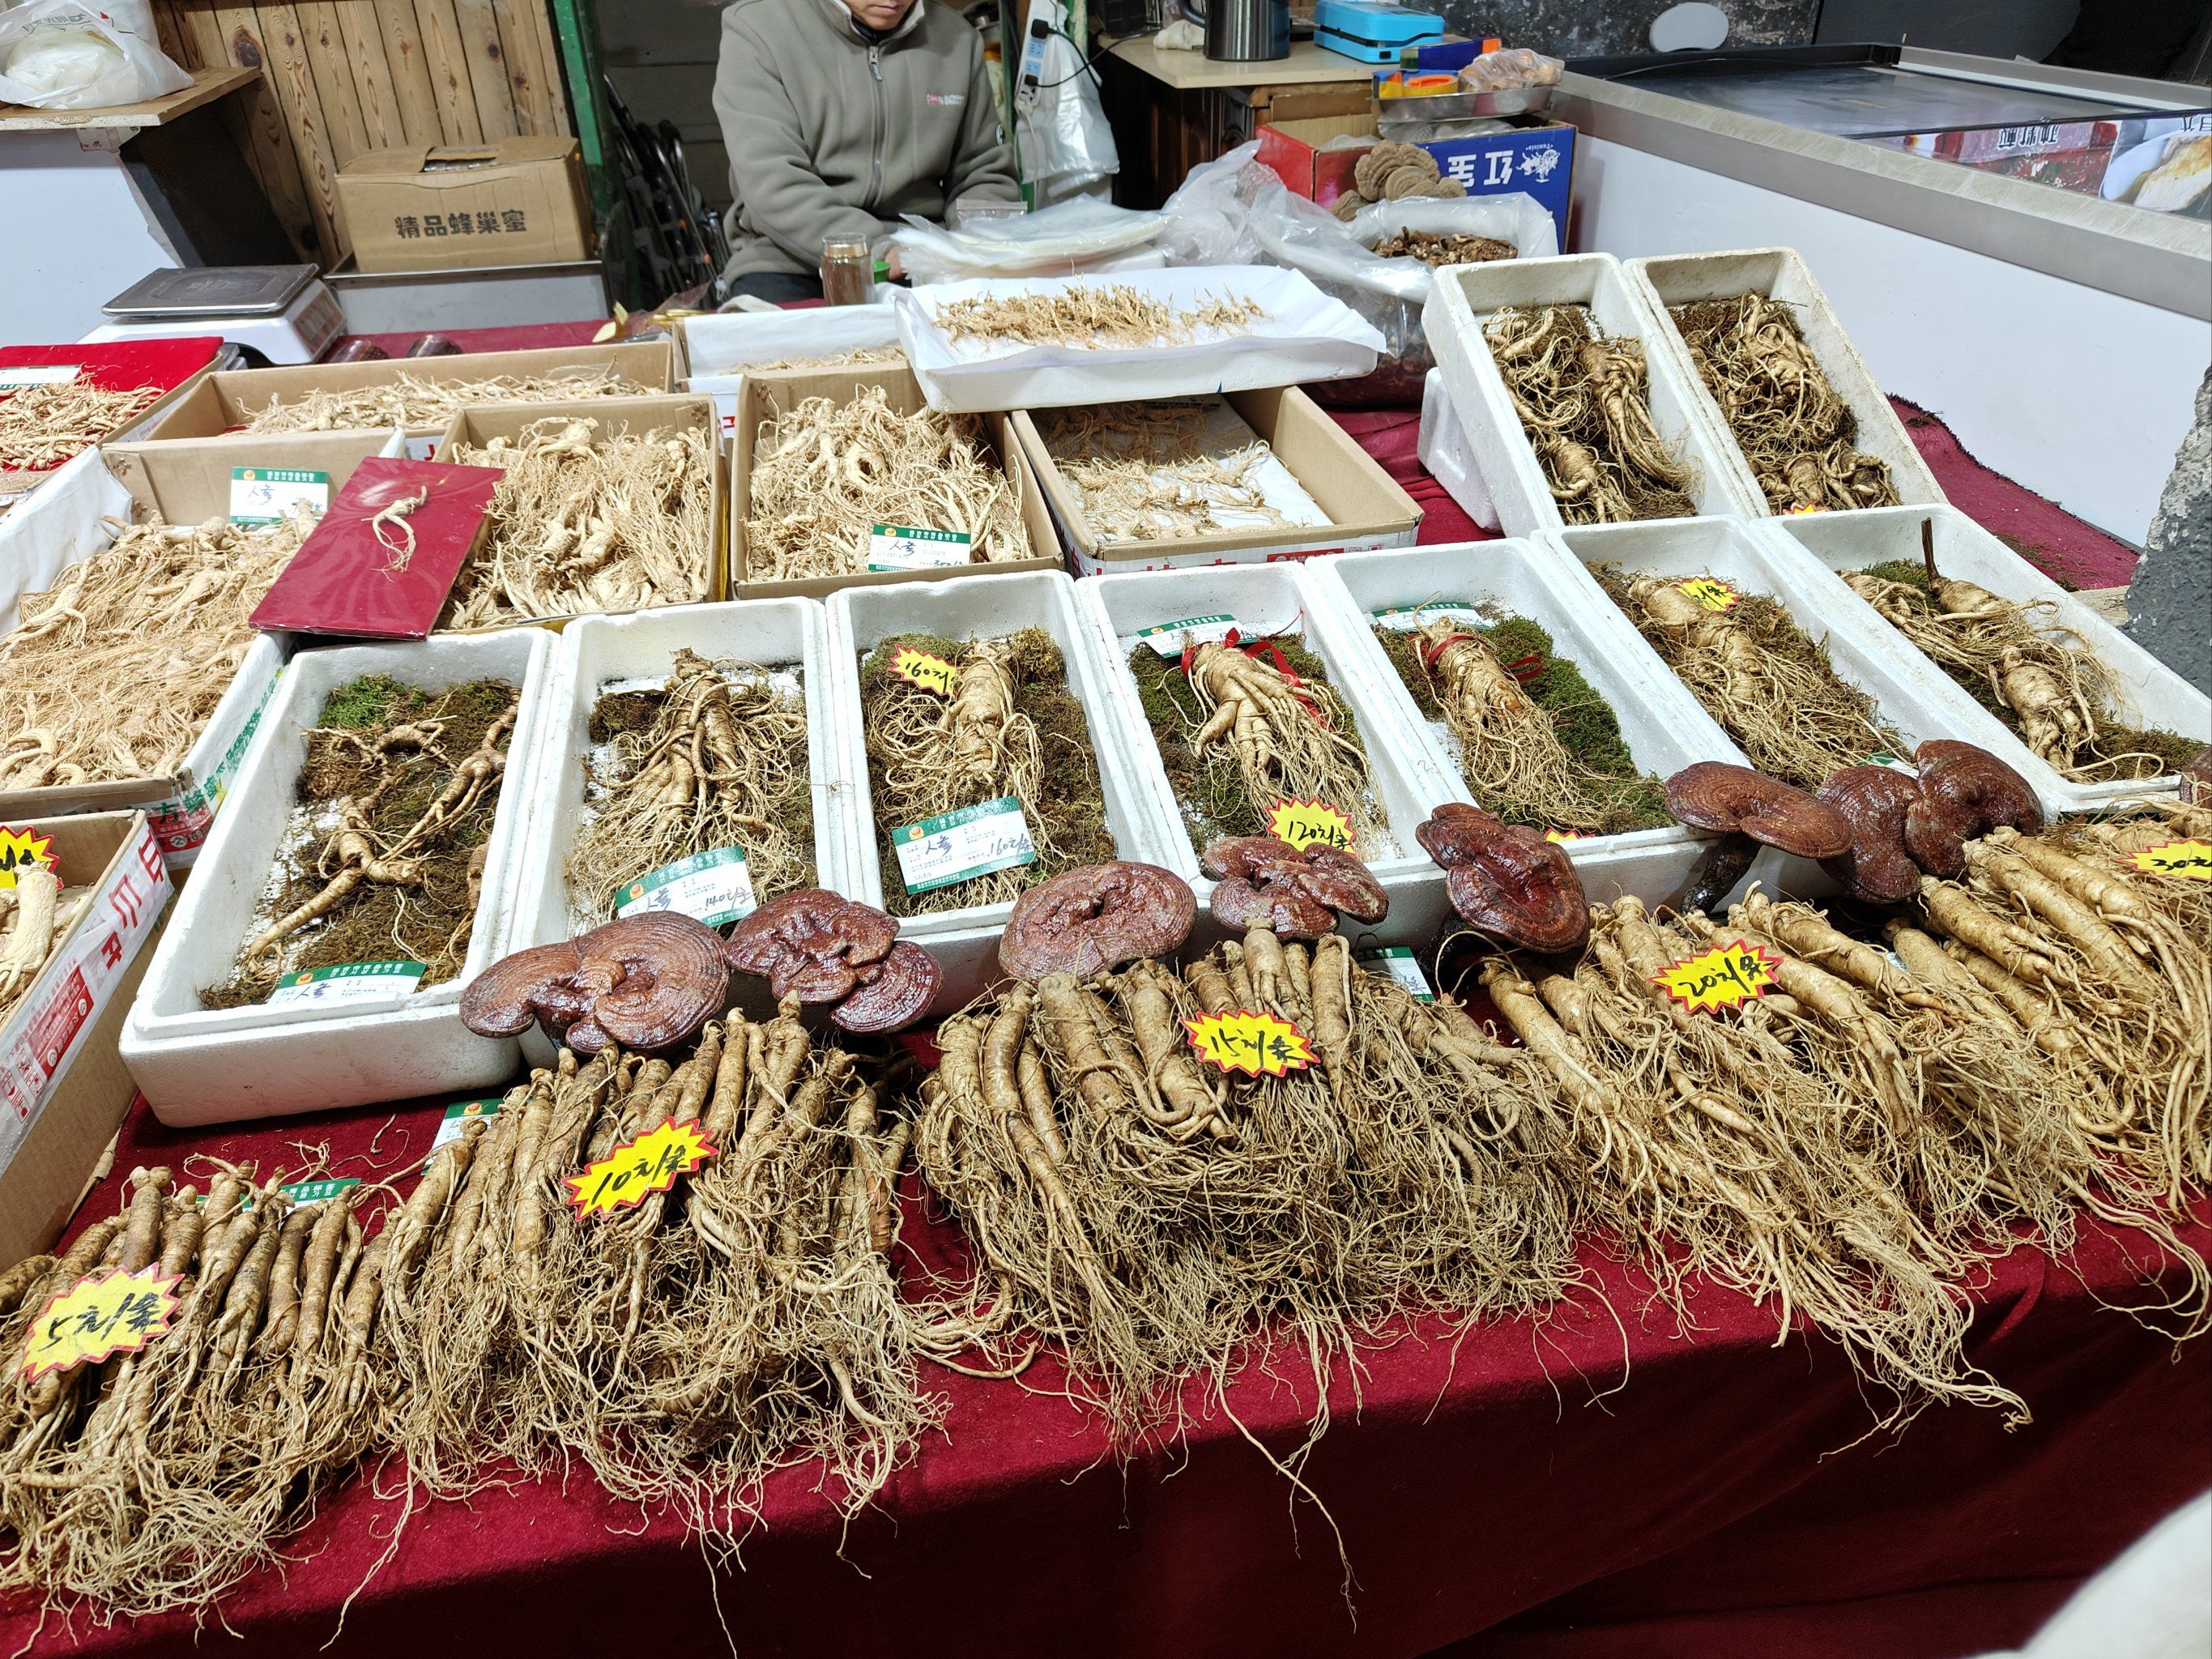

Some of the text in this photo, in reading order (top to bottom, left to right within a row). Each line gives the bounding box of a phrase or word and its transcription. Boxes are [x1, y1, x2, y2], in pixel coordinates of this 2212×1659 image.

[394, 209, 527, 239] 精品蜂巢蜜
[905, 661, 956, 693] 160元/
